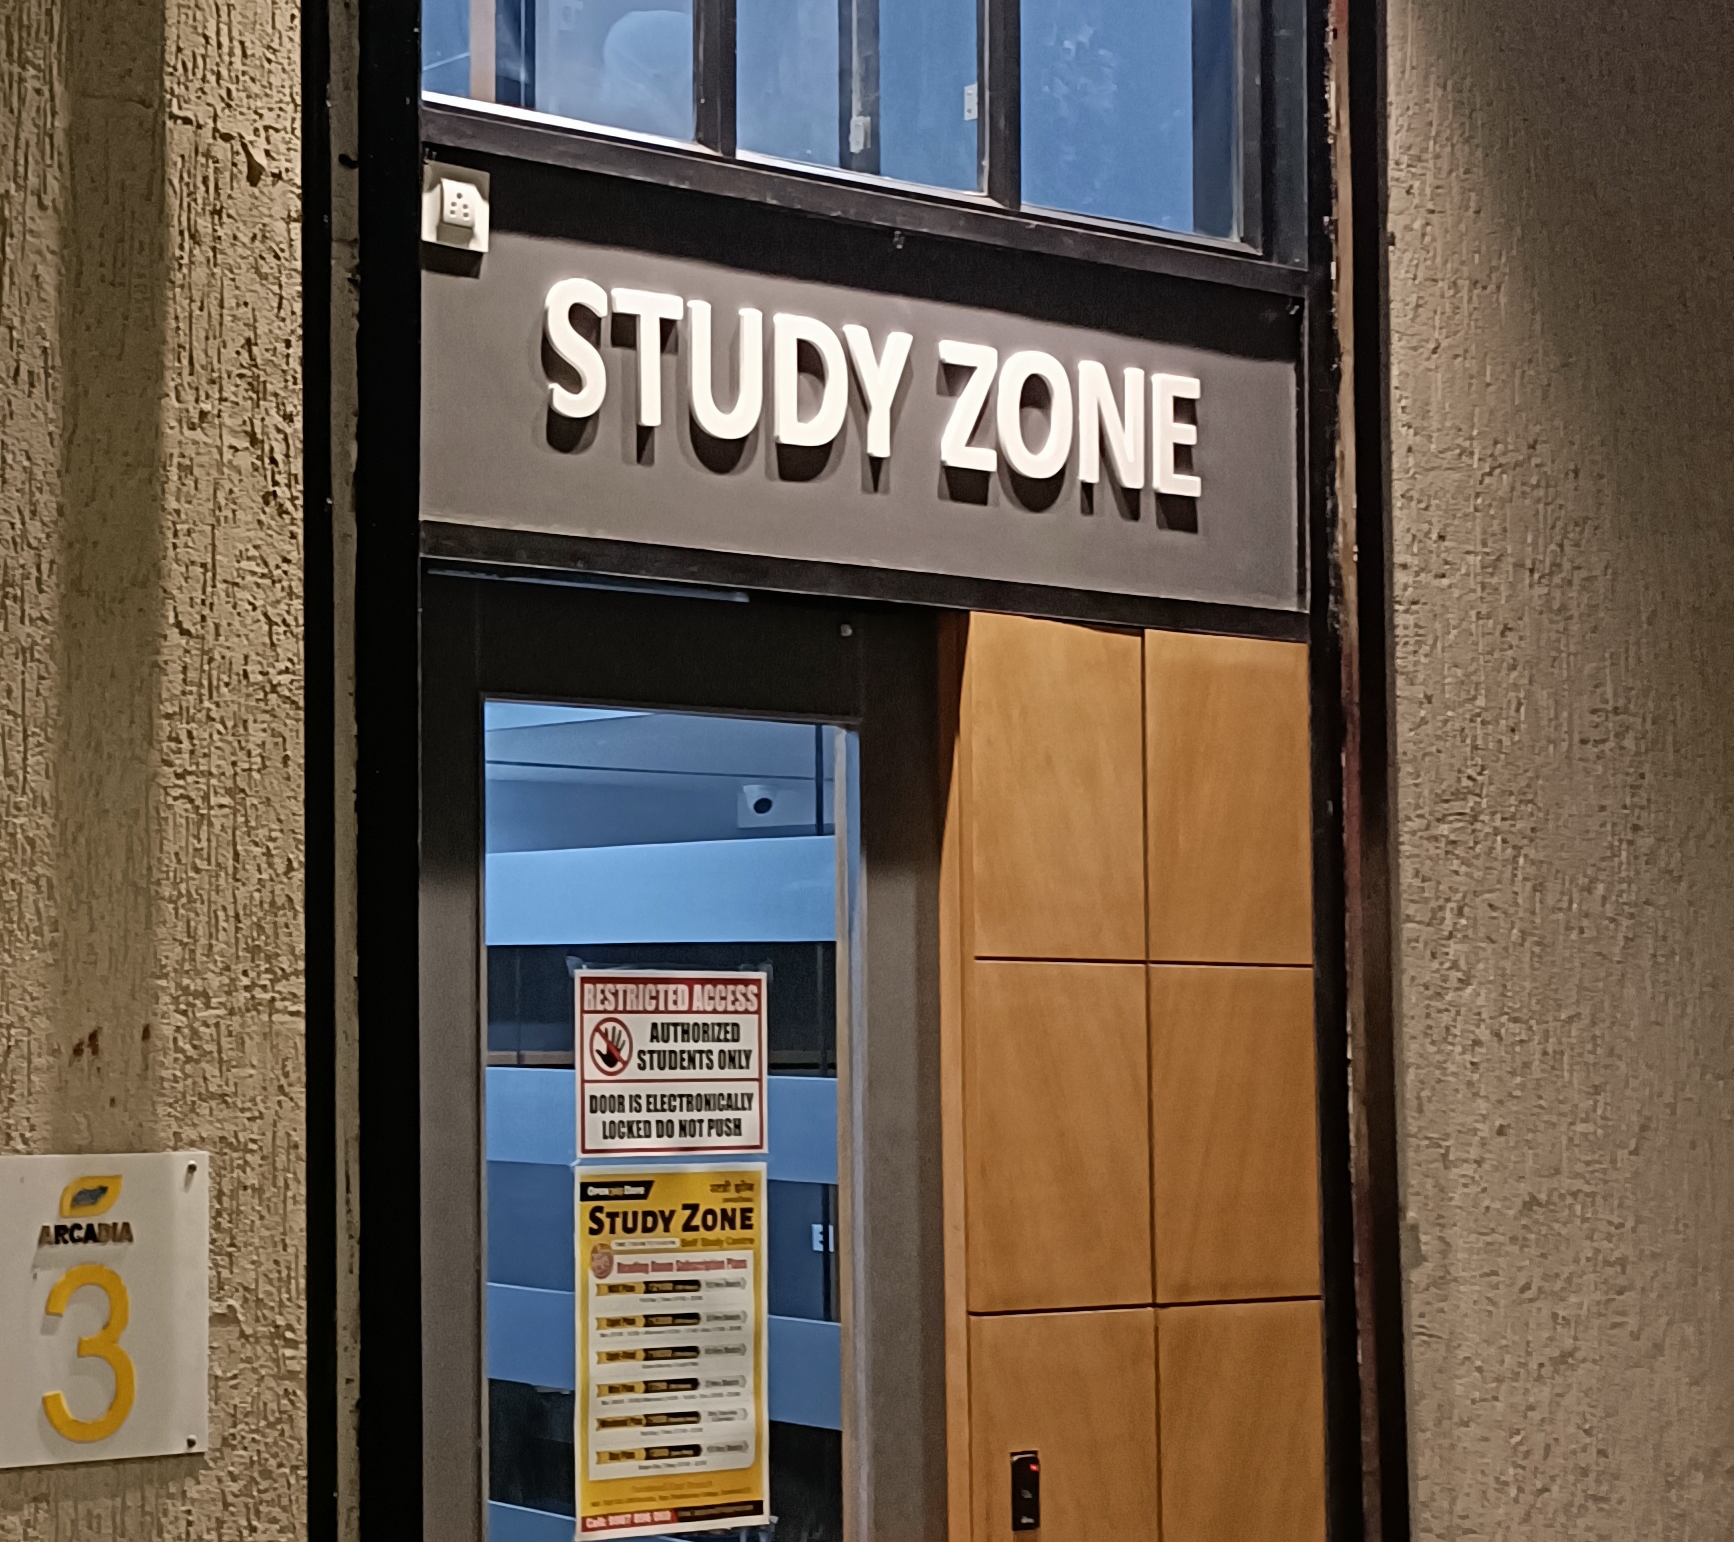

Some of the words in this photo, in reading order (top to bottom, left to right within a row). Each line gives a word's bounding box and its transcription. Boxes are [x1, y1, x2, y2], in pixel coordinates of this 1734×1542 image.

[544, 276, 914, 458] STUDY
[937, 338, 1203, 498] ZONE
[583, 983, 690, 1011] RESTRICTED
[692, 984, 759, 1012] ACCESS
[649, 1021, 741, 1044] AUTHORIZED
[636, 1049, 714, 1071] STUDENTS
[717, 1049, 753, 1070] ONLY
[588, 1093, 626, 1114] DOOR
[628, 1093, 642, 1113] IS
[645, 1092, 754, 1113] ELECTRONICALLY
[601, 1119, 652, 1140] LOCKED
[655, 1119, 675, 1139] DO
[678, 1118, 705, 1138] NOT
[707, 1117, 743, 1137] PUSH
[38, 1221, 134, 1247] ARCADIA
[41, 1263, 137, 1444] 3
